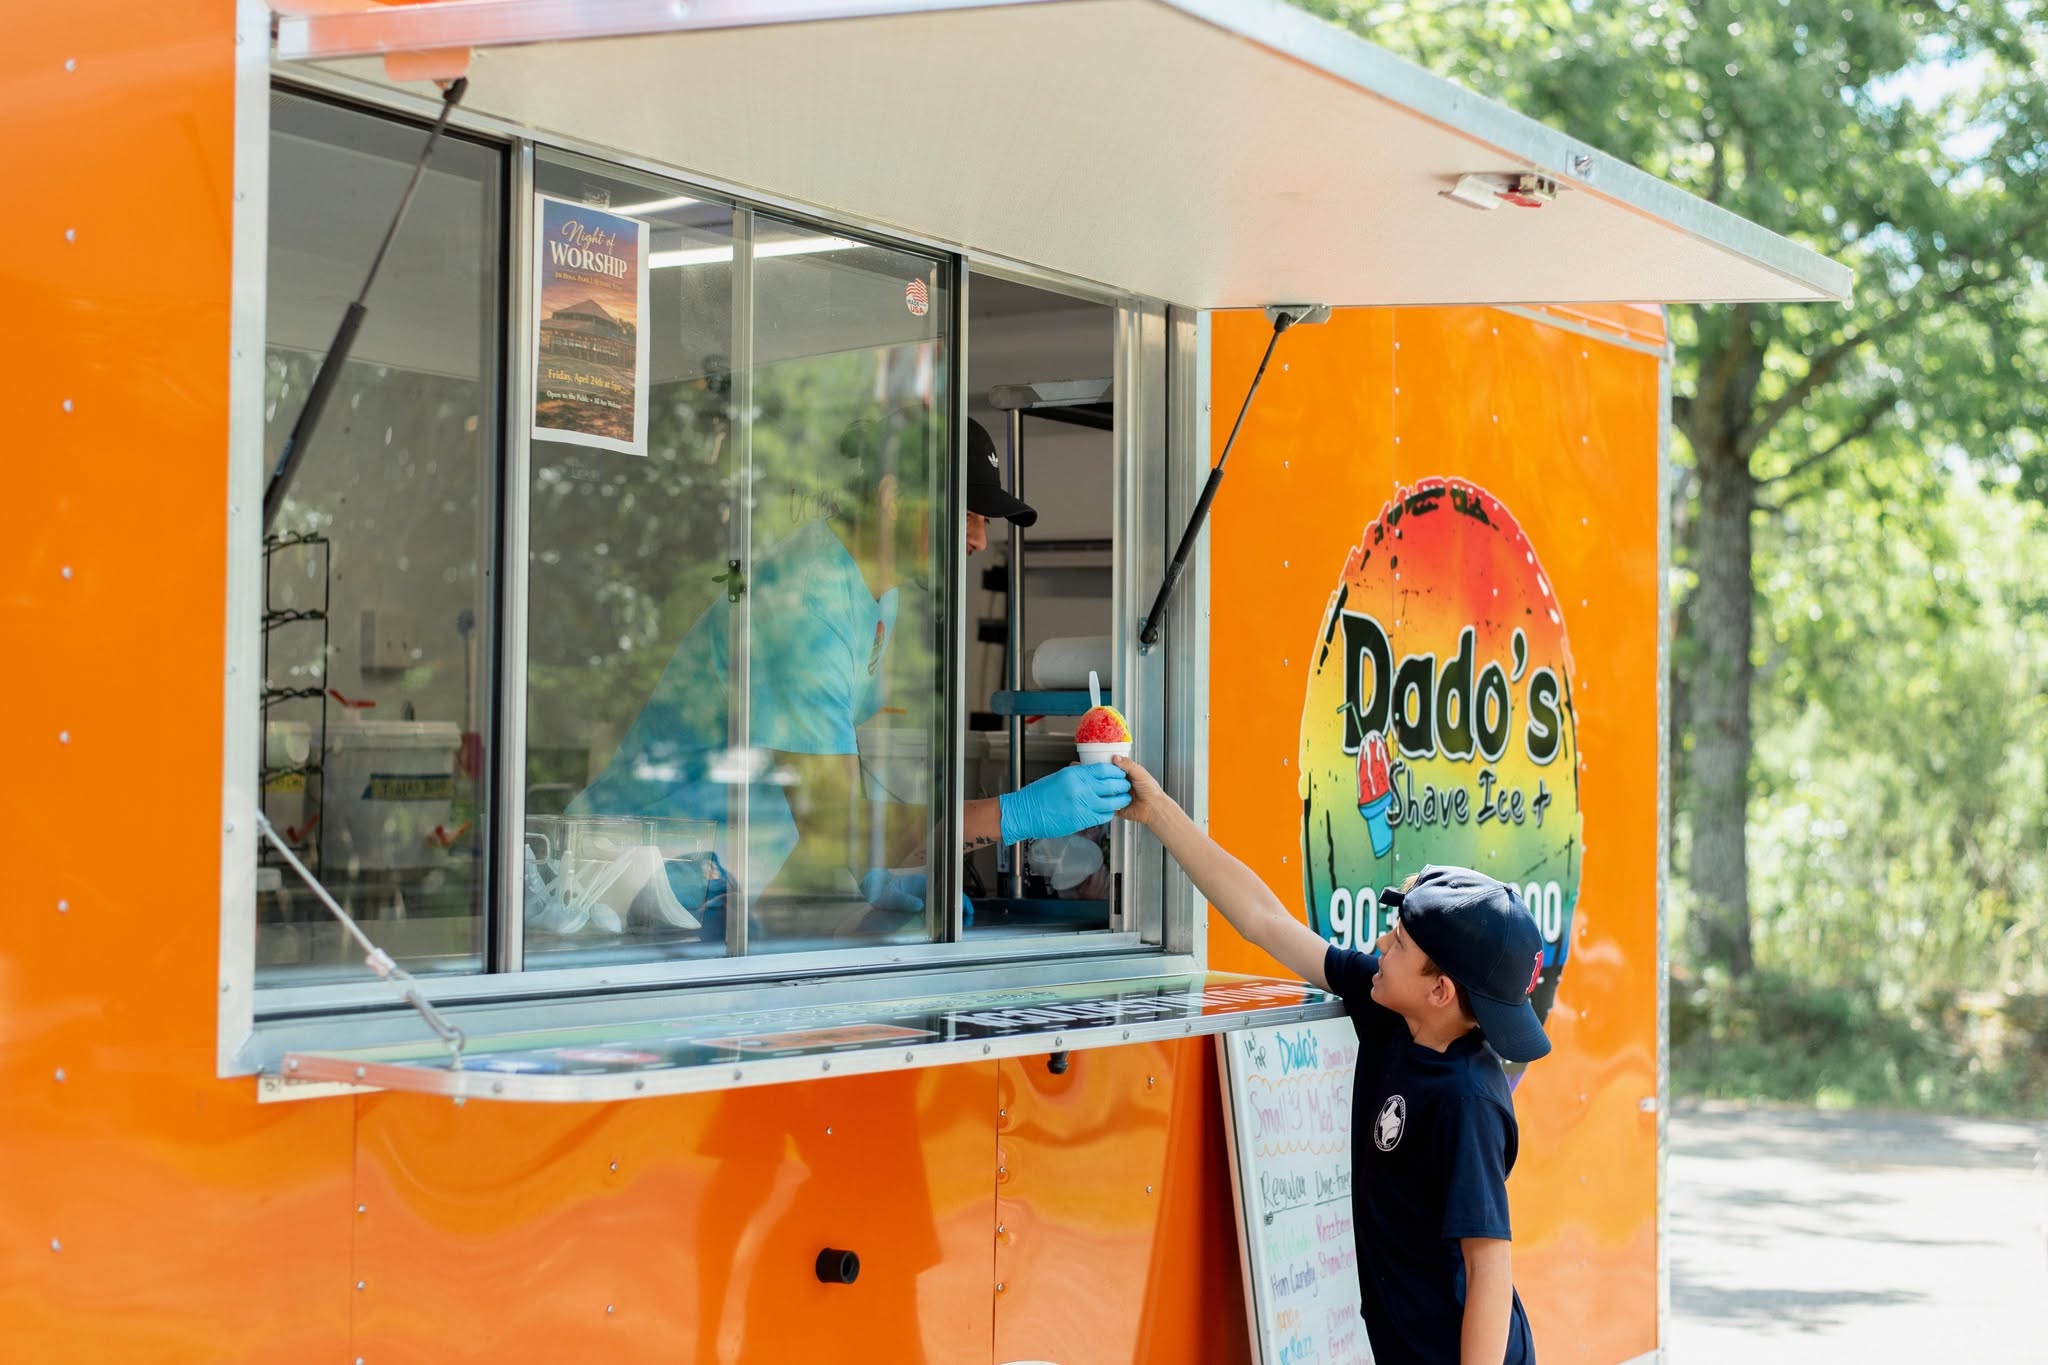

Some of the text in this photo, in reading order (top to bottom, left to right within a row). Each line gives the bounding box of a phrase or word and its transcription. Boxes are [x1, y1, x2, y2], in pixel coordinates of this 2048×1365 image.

[561, 220, 616, 255] Night of
[549, 240, 628, 279] WORSHIP
[546, 389, 561, 399] Open
[547, 368, 573, 383] Friday,
[574, 372, 590, 385] April
[1340, 610, 1561, 764] Dado's
[1385, 759, 1469, 828] Shave
[1476, 767, 1525, 824] Ice
[1274, 1028, 1318, 1075] Dado's
[1250, 1089, 1288, 1140] Small
[1261, 1170, 1306, 1209] Regular
